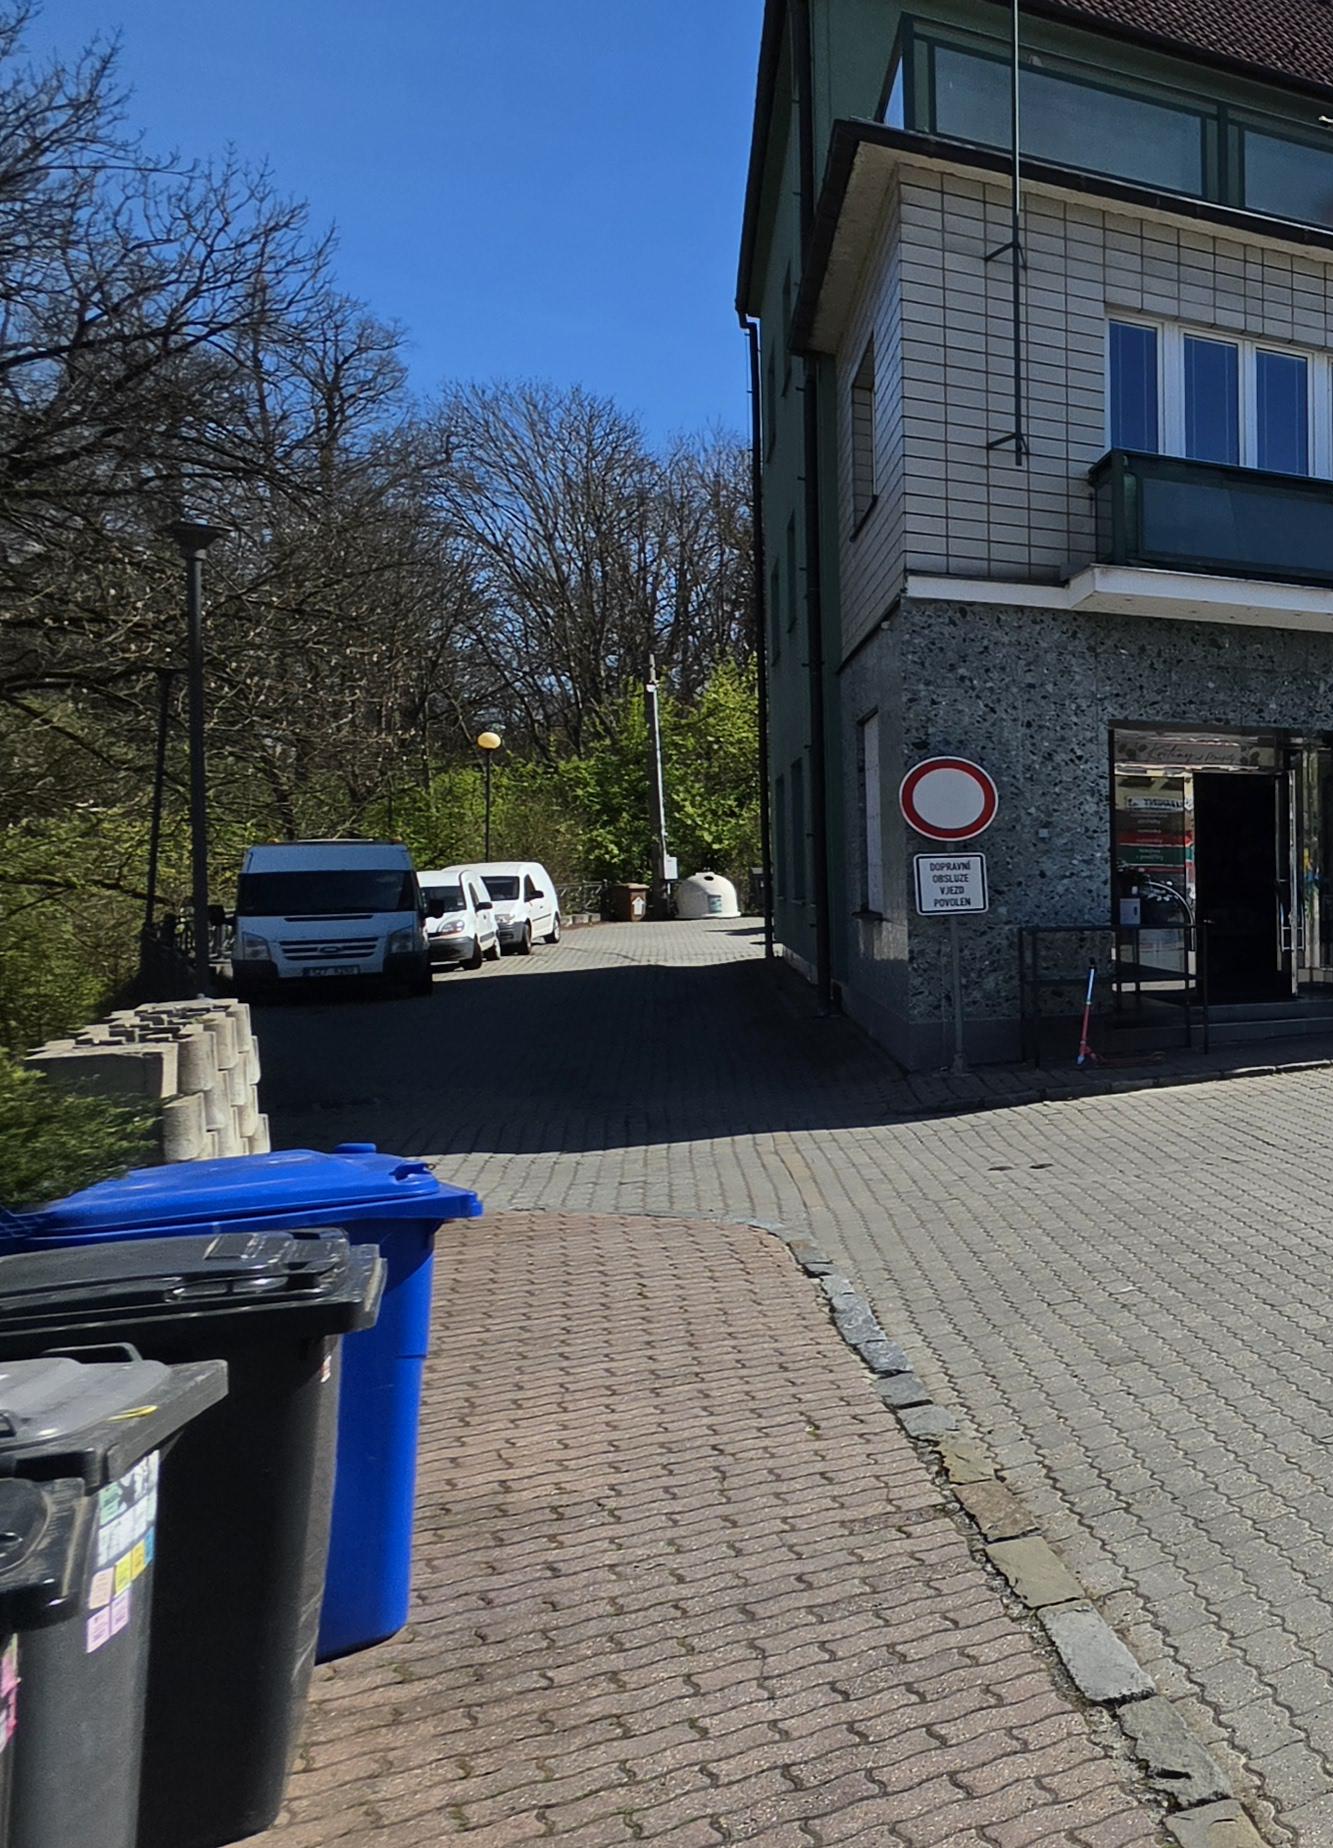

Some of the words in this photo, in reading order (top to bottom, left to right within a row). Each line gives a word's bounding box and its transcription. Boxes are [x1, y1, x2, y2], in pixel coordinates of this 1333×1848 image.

[929, 860, 971, 871] DOPRAVNÍ
[932, 873, 969, 883] OBSLUZE
[939, 885, 965, 895] VJEZD
[933, 897, 971, 907] POVOLEN
